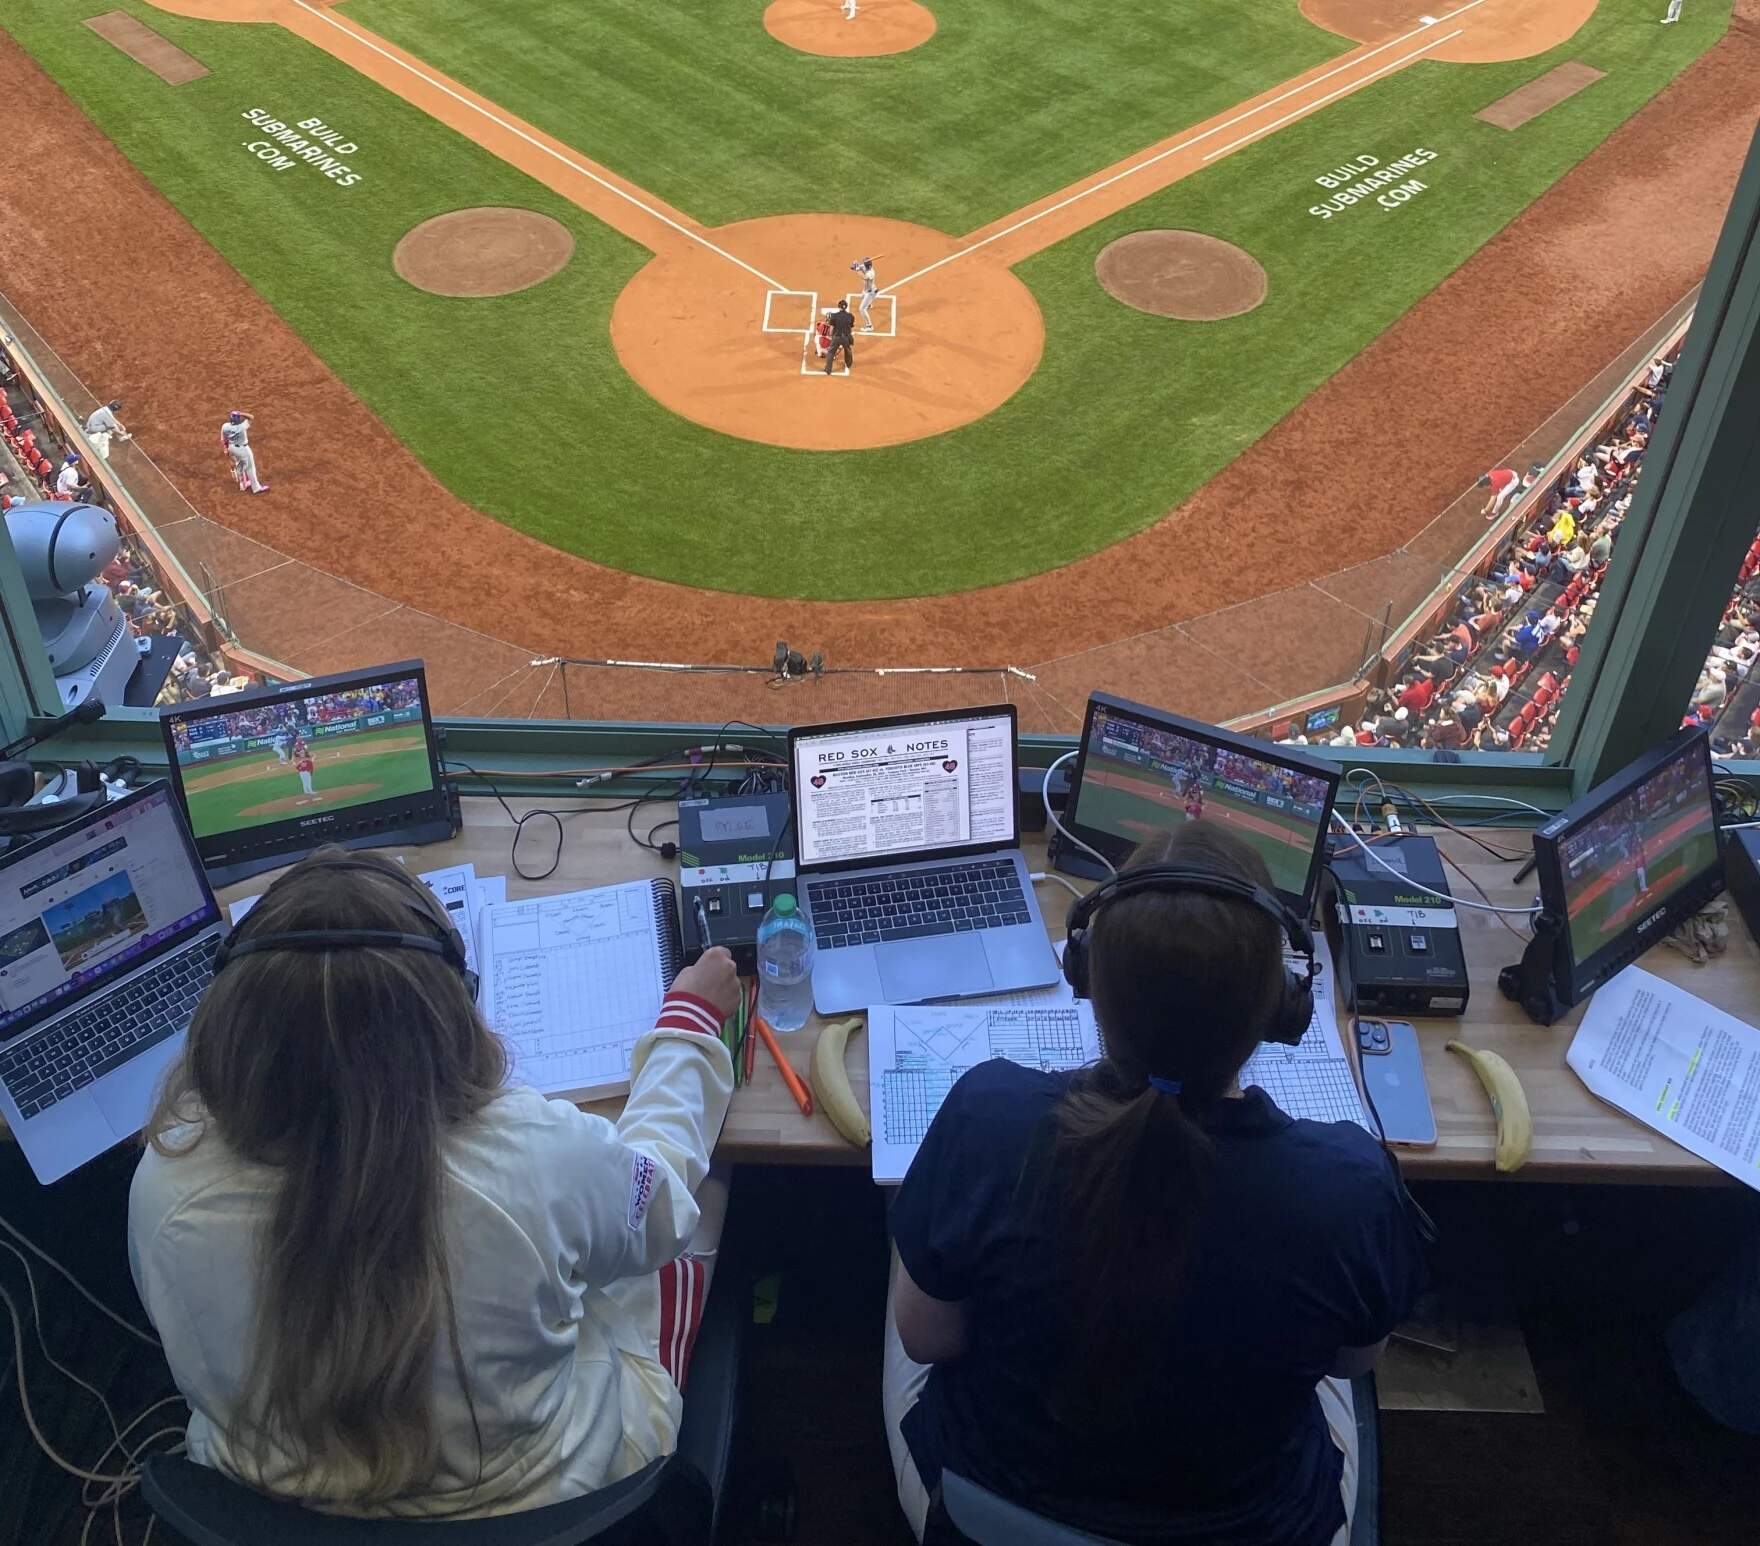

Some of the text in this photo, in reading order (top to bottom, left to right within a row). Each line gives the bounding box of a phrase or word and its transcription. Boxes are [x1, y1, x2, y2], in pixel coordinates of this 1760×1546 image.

[241, 108, 363, 186] SUBMARINES
[297, 117, 359, 154] BUILD
[242, 141, 296, 171] .COM
[1308, 147, 1439, 219] SUBMARINES
[1315, 154, 1379, 188] BUILD
[1377, 179, 1428, 212] .COM
[169, 714, 182, 723] 4K
[325, 721, 357, 732] National
[819, 751, 845, 762] RED
[851, 747, 878, 759] SOX
[906, 740, 949, 752] NOTES
[299, 815, 335, 827] SEETEC
[738, 854, 765, 862] Model
[1394, 895, 1422, 904] Model
